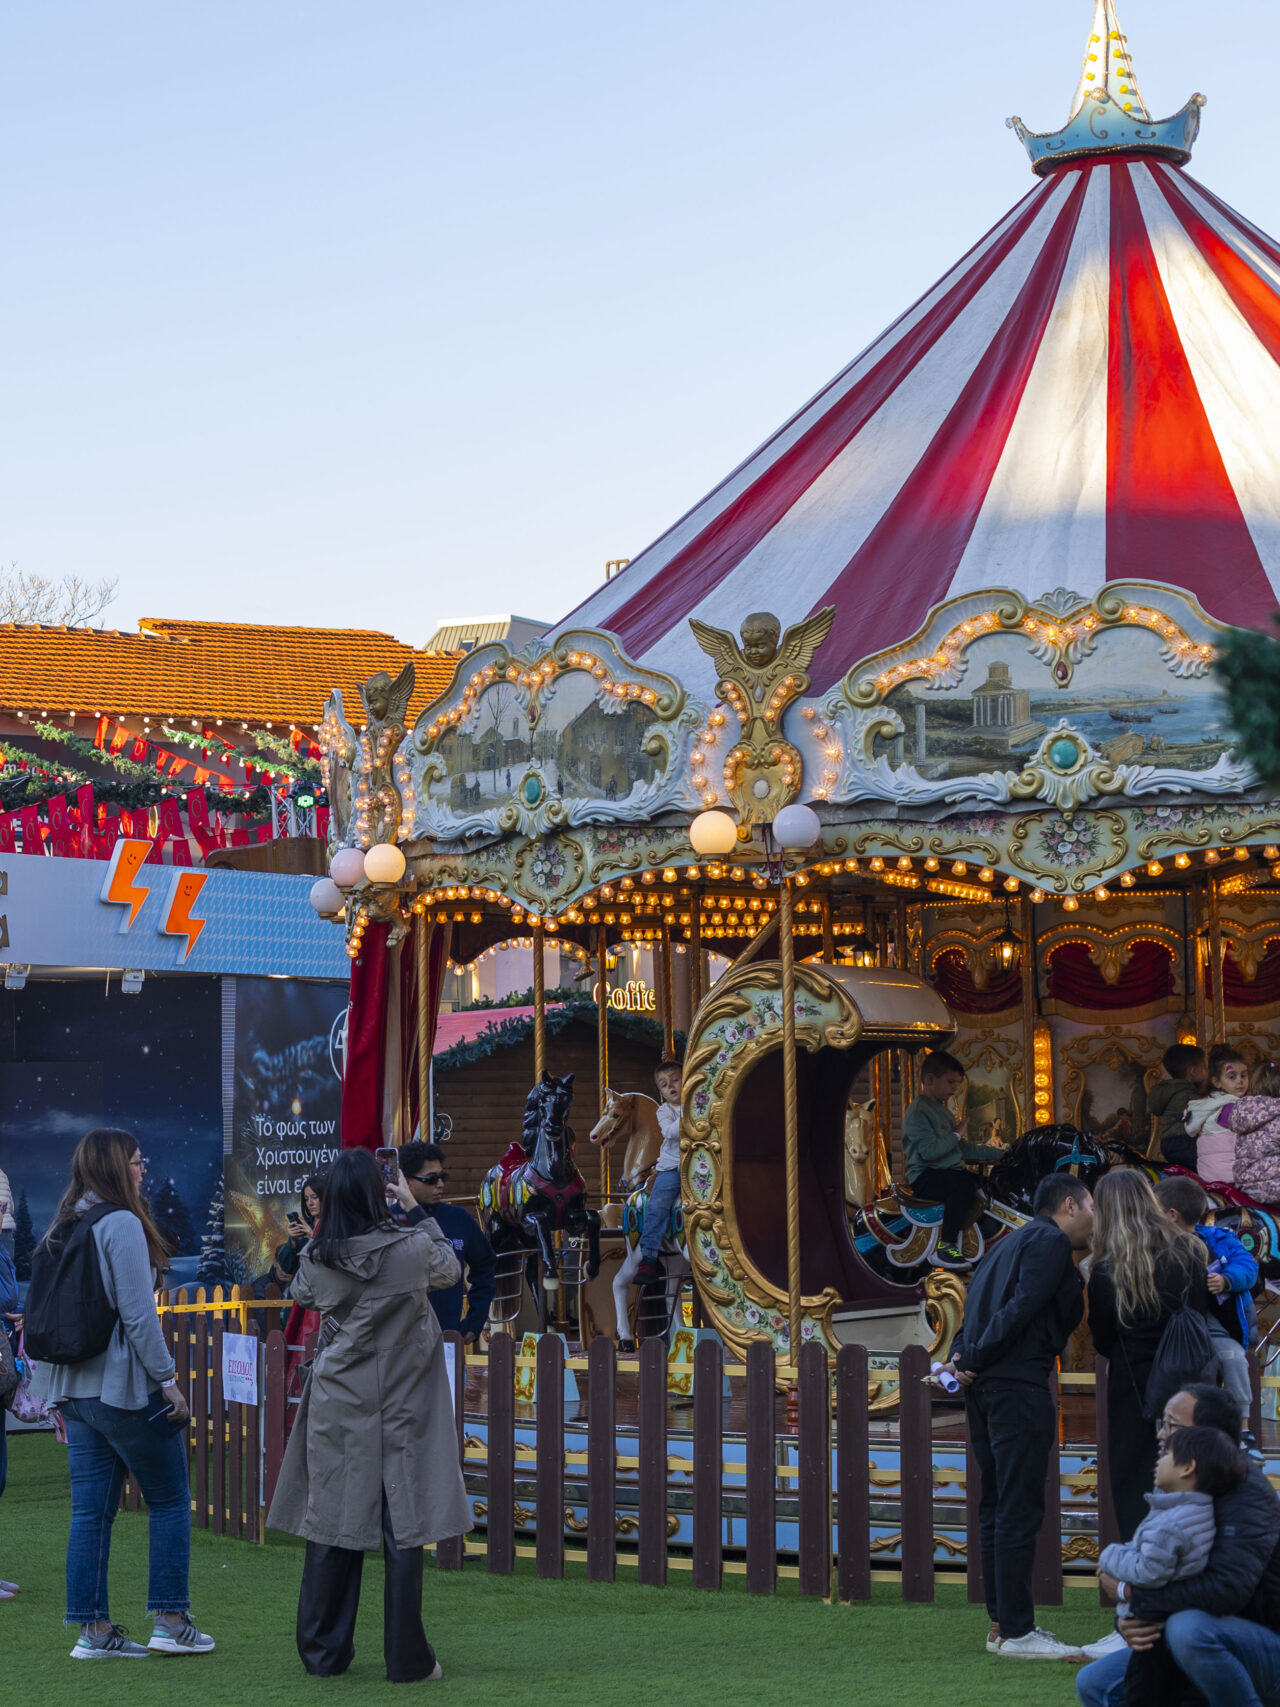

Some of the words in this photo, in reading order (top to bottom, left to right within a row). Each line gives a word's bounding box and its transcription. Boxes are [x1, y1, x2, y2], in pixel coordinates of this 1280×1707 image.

[593, 980, 656, 1011] Coffe
[256, 1117, 273, 1136] Το
[276, 1120, 307, 1141] φως
[309, 1120, 336, 1135] των
[256, 1143, 341, 1170] Χριστουγένν
[256, 1175, 291, 1194] είναι
